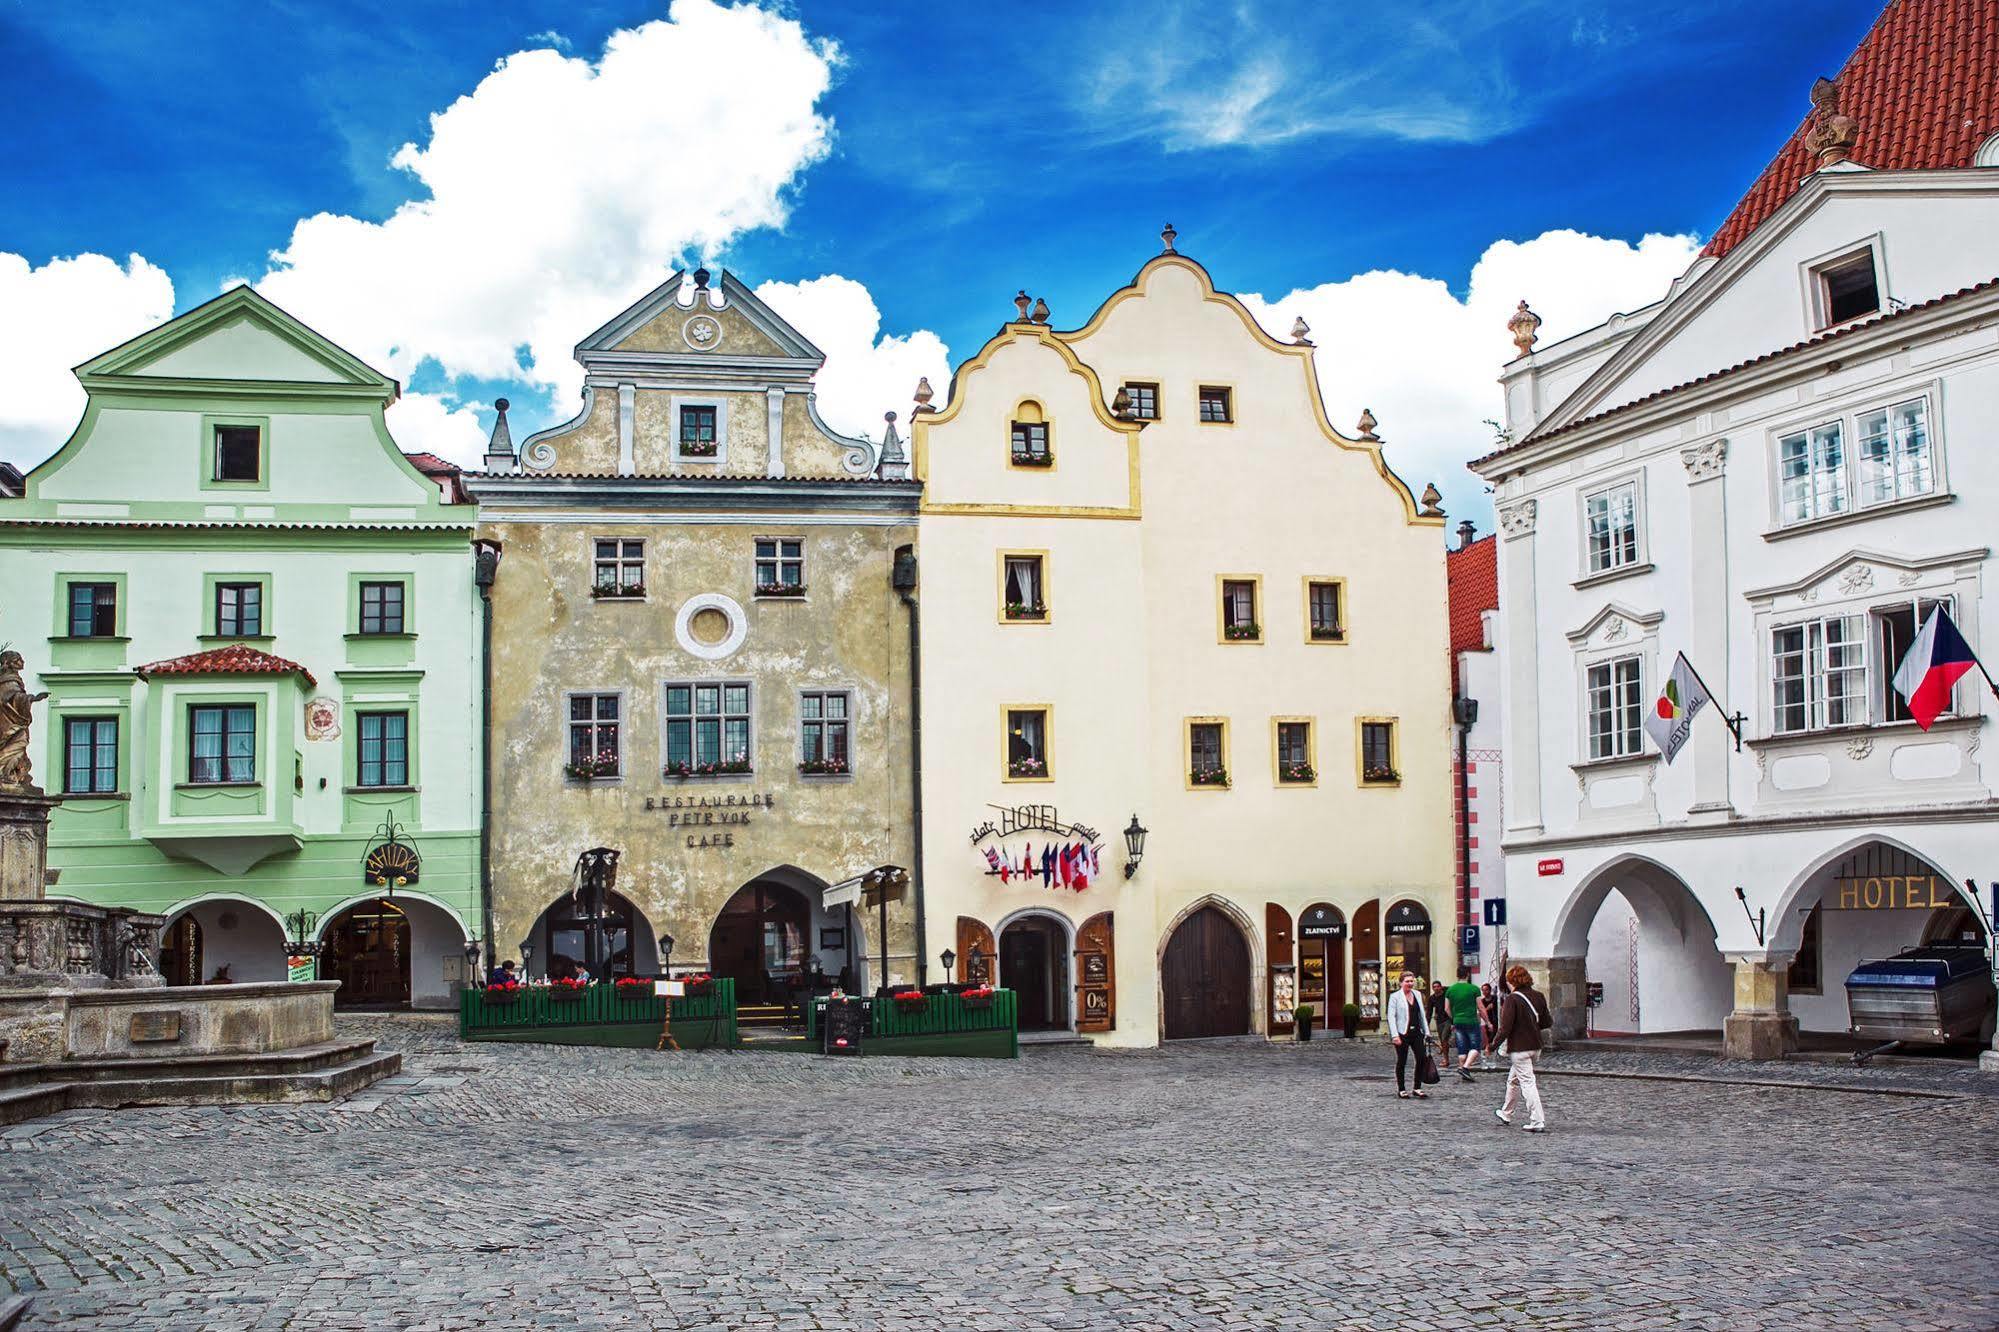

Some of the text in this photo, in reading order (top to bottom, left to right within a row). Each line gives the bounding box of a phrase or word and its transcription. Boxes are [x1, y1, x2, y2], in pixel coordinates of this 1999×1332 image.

[669, 813, 713, 827] PETR
[1001, 804, 1066, 836] HOTEL
[687, 833, 734, 848] CAFE
[1840, 876, 1950, 908] HOTEL
[1392, 924, 1425, 932] JEWELLERY
[1466, 929, 1475, 944] P
[1087, 992, 1107, 1009] 0%
